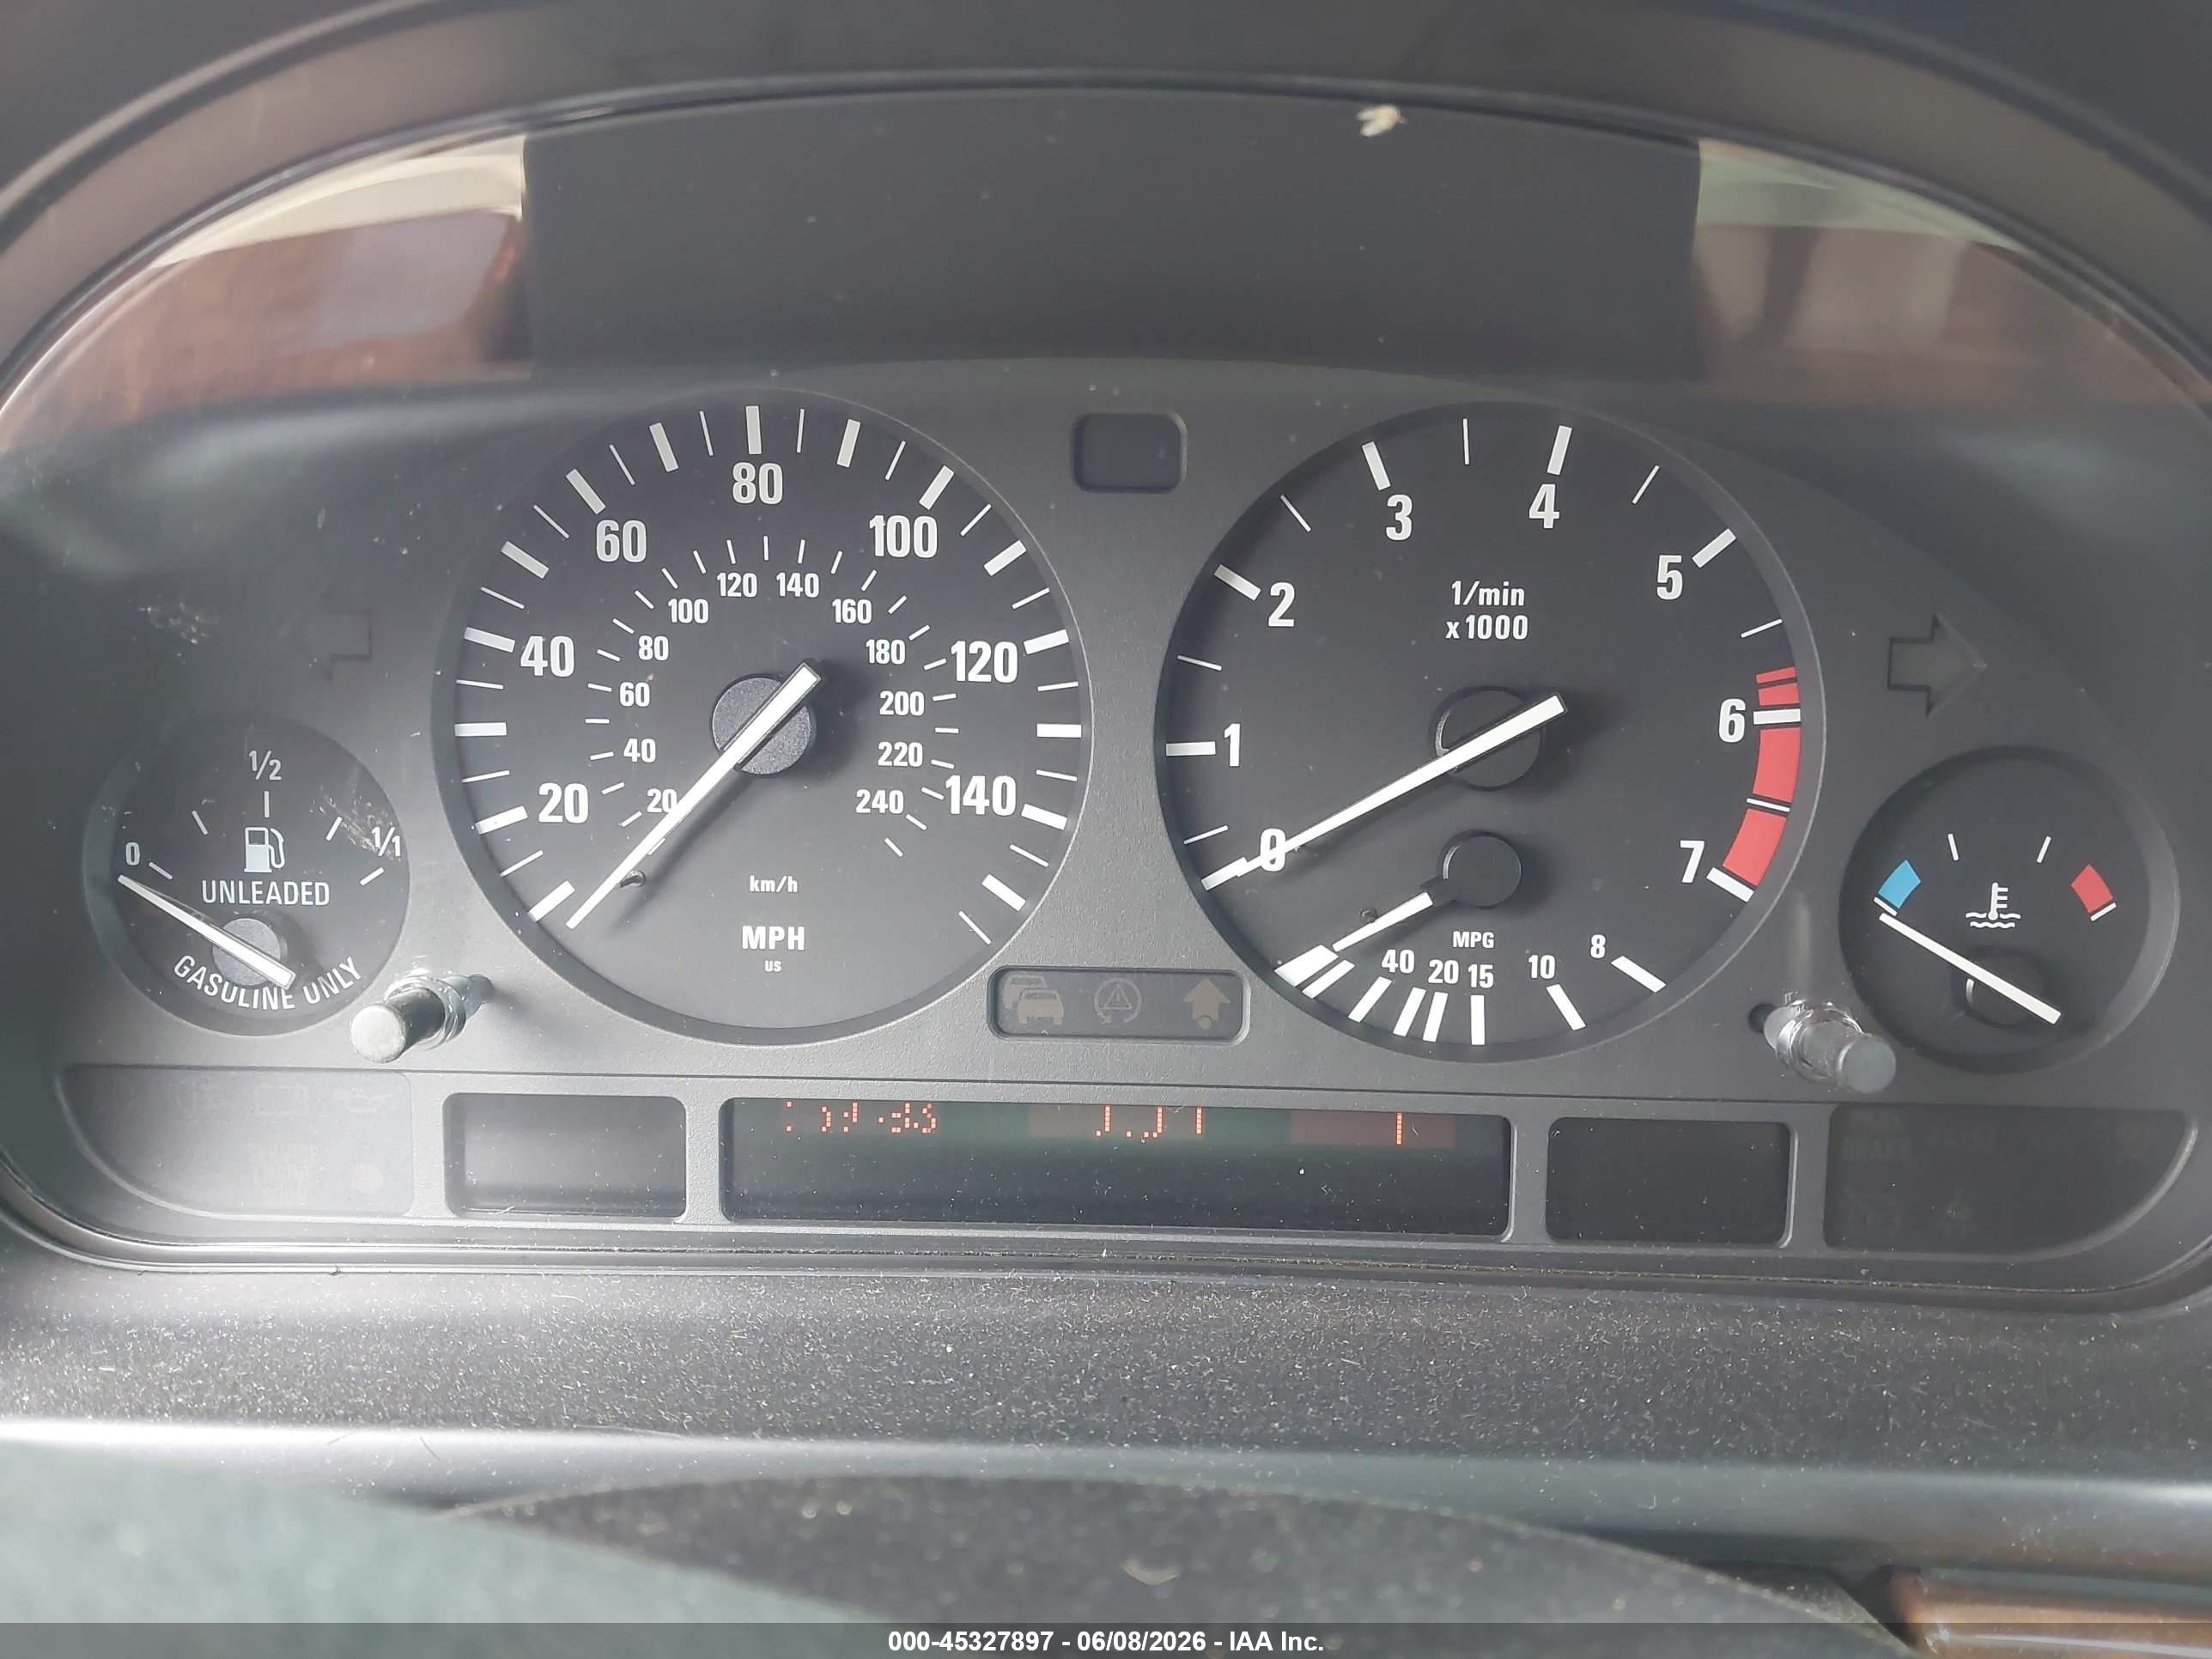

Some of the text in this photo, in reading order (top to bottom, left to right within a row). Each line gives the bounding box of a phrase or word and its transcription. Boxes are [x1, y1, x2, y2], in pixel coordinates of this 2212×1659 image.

[732, 461, 784, 506] 80
[1384, 493, 1413, 542] 3
[1528, 483, 1561, 530] 4
[595, 519, 647, 563] 60
[868, 514, 939, 559] 100
[715, 571, 758, 599] 120
[775, 571, 820, 599] 140
[1656, 554, 1684, 601] 5
[1267, 580, 1296, 628] 2
[1450, 580, 1526, 607] 1/min
[666, 597, 710, 625] 100
[830, 598, 873, 625] 160
[520, 635, 575, 678] 40
[637, 634, 670, 662] 80
[865, 638, 907, 665] 180
[950, 640, 1019, 684] 120
[618, 681, 651, 708] 60
[878, 690, 926, 717] 200
[1717, 697, 1747, 744] 6
[623, 737, 657, 764] 40
[877, 740, 924, 769] 220
[1223, 722, 1242, 768] 1
[247, 749, 283, 781] 1/2
[538, 781, 590, 824] 20
[646, 787, 678, 816] 20
[854, 787, 905, 815] 240
[945, 774, 1018, 817] 140
[125, 841, 142, 867] 0
[371, 825, 401, 857] 1/1
[1260, 827, 1286, 872] 0
[1679, 839, 1706, 884] 7
[201, 878, 331, 907] UNLEADED
[748, 873, 799, 895] km/h
[741, 924, 805, 951] MPH
[1451, 929, 1495, 950] MPG
[1589, 933, 1607, 960] 8
[1380, 948, 1416, 975] 40
[1426, 958, 1460, 985] 20
[1527, 953, 1557, 981] 10
[1467, 963, 1495, 989] 15
